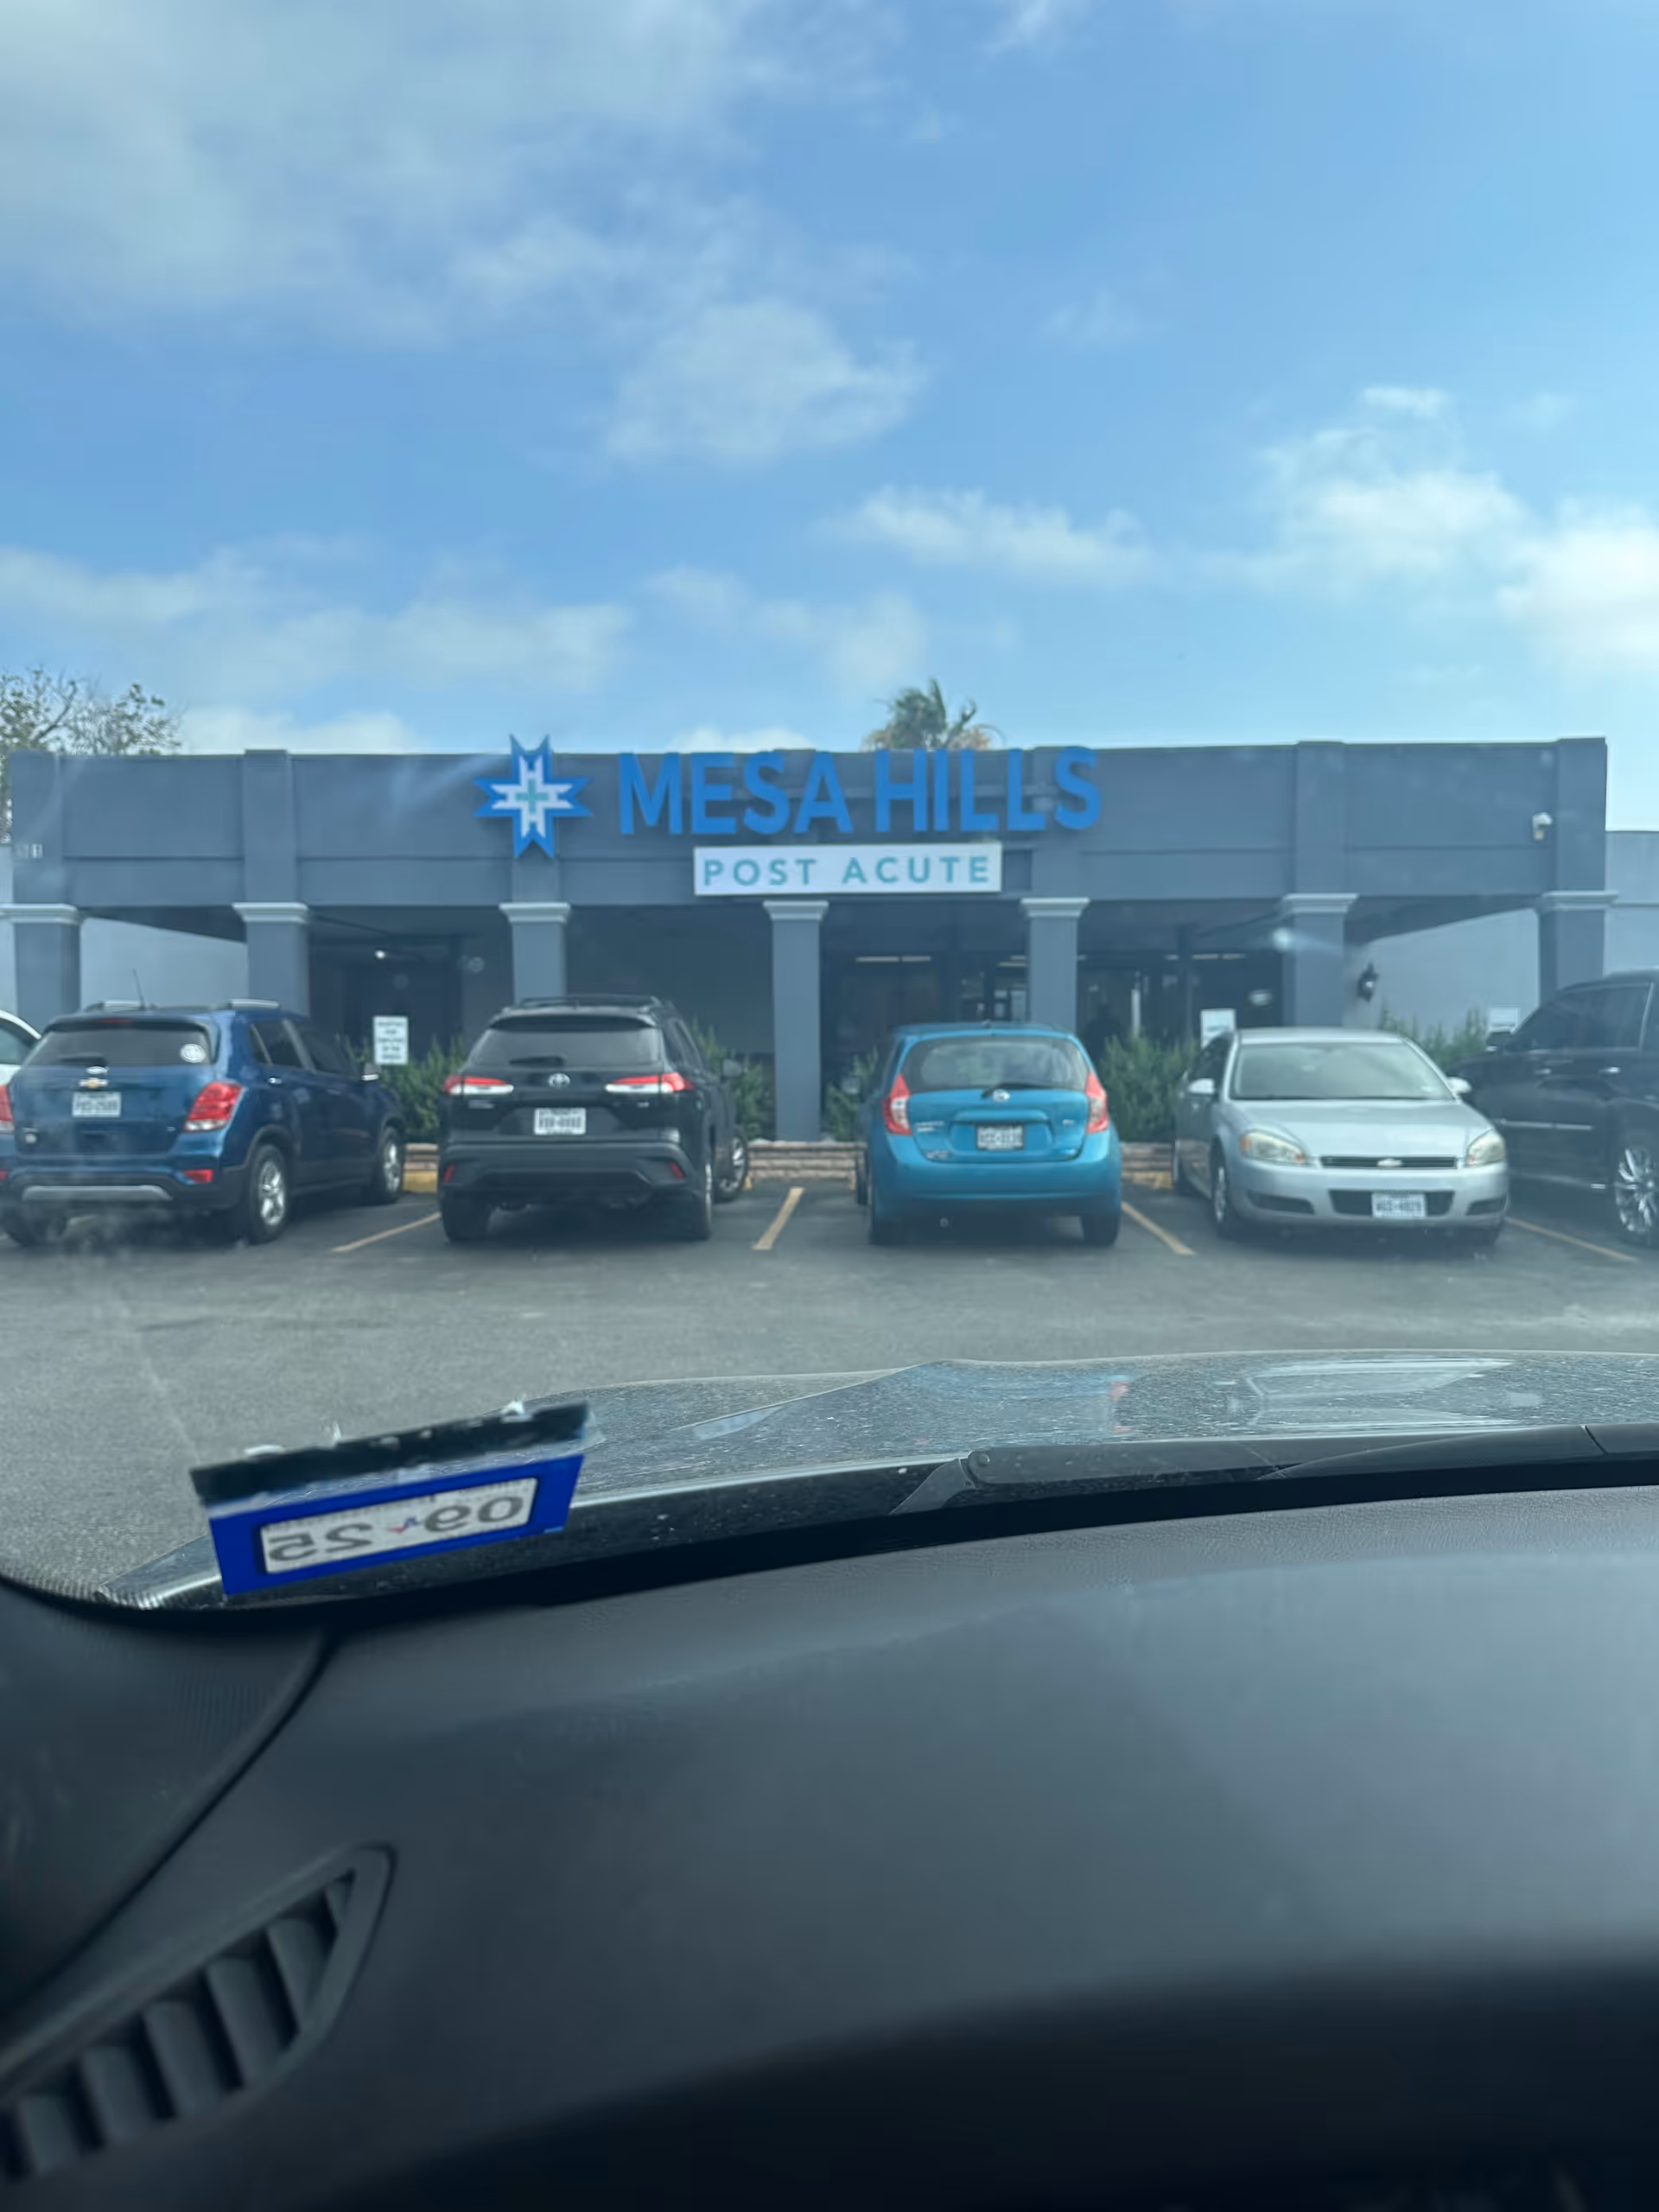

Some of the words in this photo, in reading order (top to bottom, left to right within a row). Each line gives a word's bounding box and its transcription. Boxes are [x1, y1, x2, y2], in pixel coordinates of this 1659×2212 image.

[620, 752, 854, 835] MESA
[875, 747, 1100, 832] HILLS
[703, 858, 817, 887] POST
[842, 856, 988, 884] ACUTE
